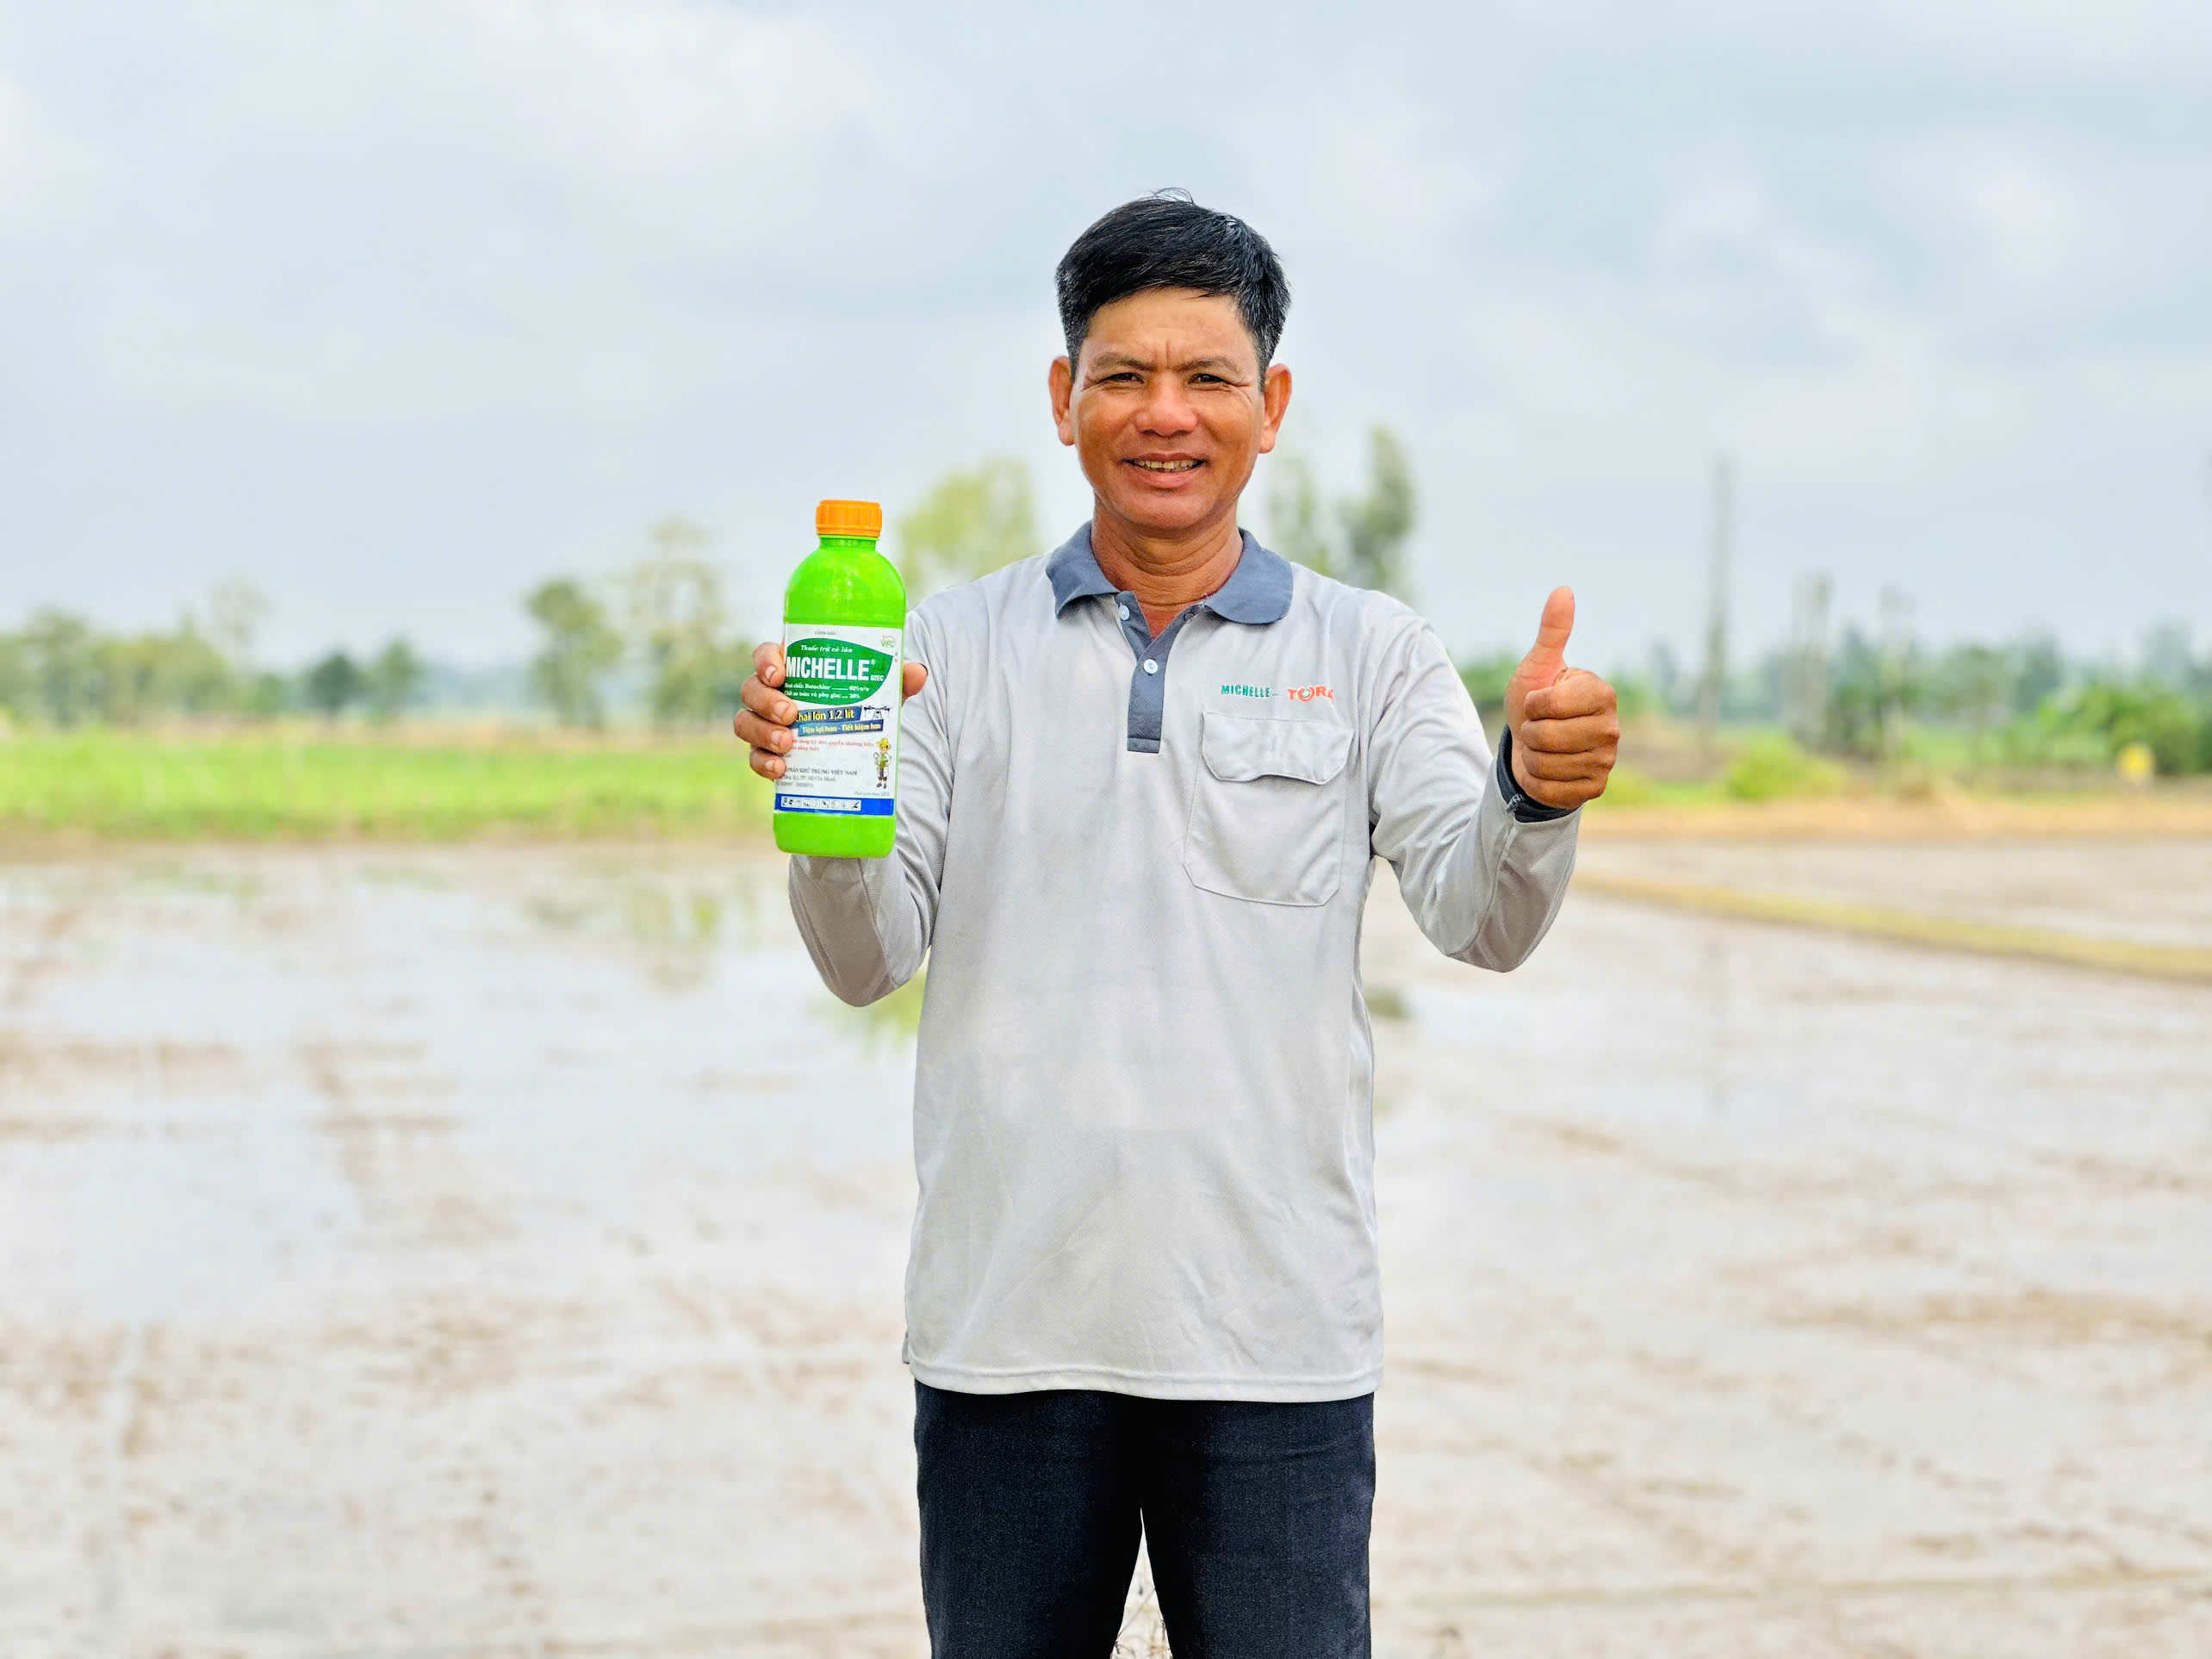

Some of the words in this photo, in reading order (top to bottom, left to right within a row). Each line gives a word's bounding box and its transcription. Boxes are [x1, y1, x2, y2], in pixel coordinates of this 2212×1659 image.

[786, 656, 869, 680] MICHELLE
[1221, 685, 1270, 698] MICHELLE
[812, 711, 826, 721] lớn
[829, 709, 842, 720] 1,2
[846, 709, 854, 718] lít
